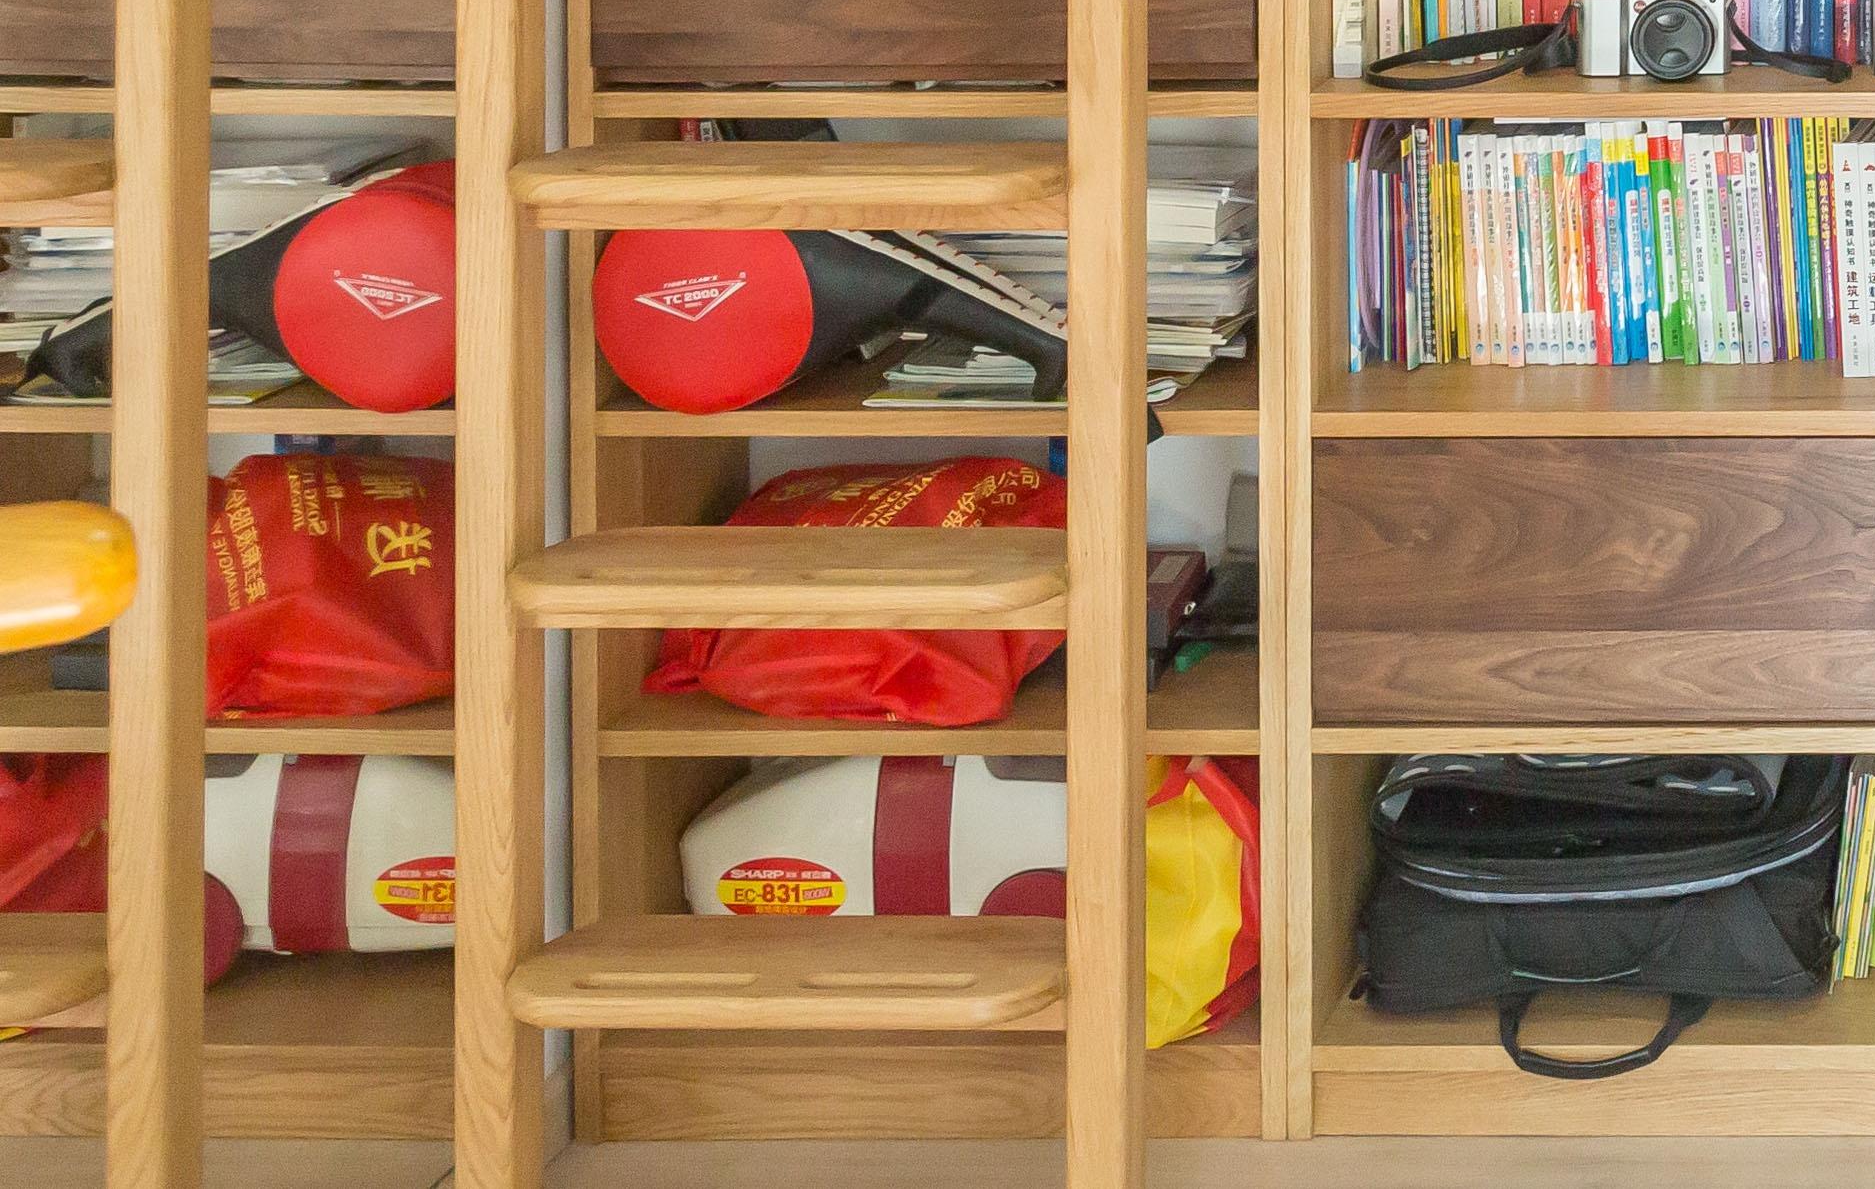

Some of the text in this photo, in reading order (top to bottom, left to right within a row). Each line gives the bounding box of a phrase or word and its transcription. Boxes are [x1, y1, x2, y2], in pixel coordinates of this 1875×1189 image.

[663, 294, 683, 306] TC
[1846, 270, 1861, 326] 建筑工地
[730, 870, 785, 879] SHARP
[734, 883, 801, 904] EC-831
